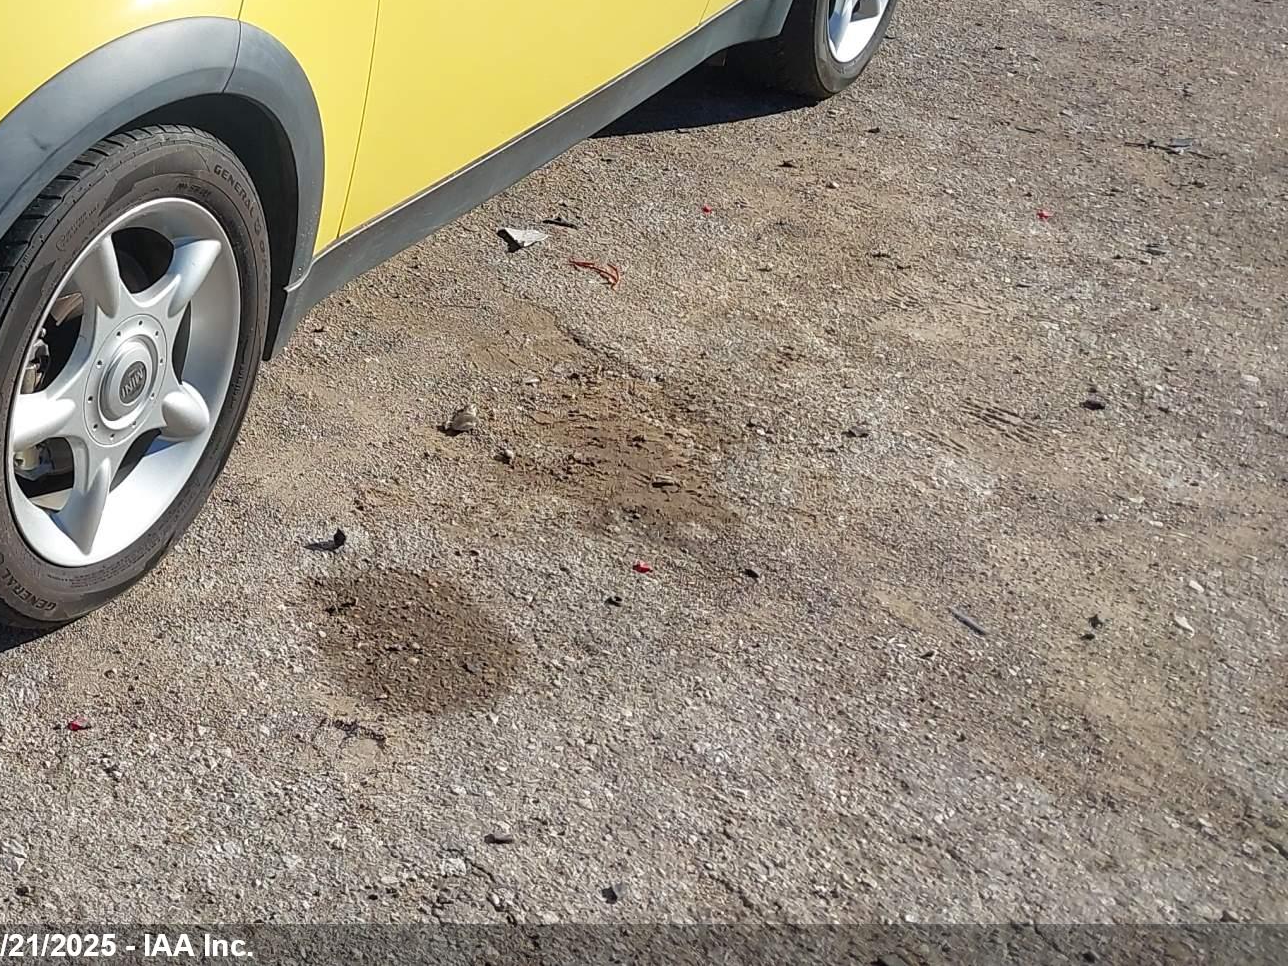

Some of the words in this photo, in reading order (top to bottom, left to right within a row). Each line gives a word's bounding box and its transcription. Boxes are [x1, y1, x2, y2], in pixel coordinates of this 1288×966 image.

[214, 164, 255, 218] GENERAL
[122, 368, 143, 398] MINI
[2, 568, 57, 612] GENERAL
